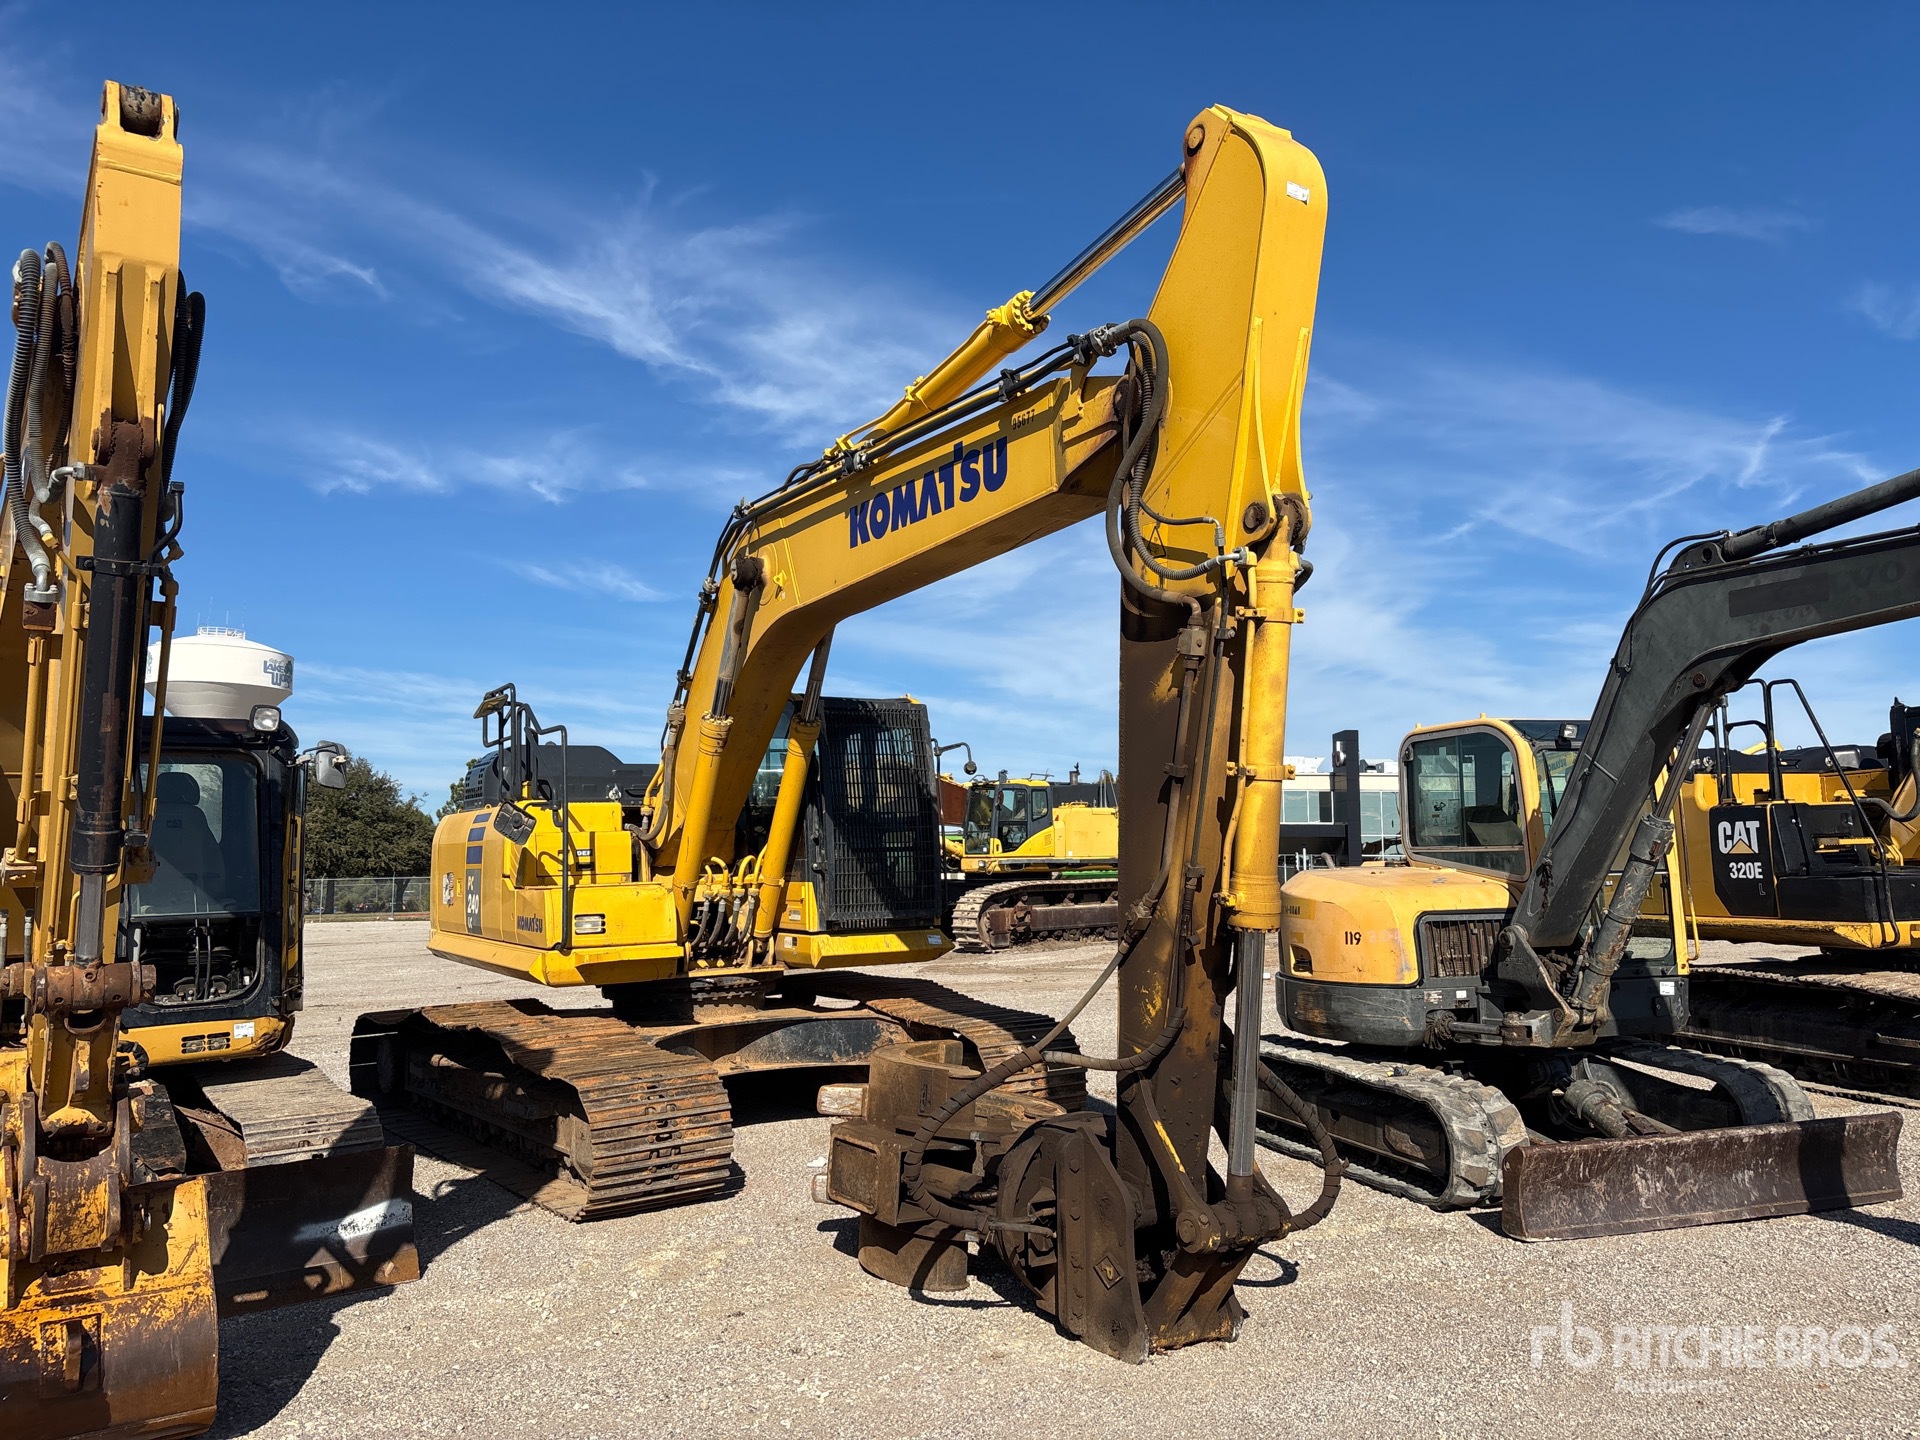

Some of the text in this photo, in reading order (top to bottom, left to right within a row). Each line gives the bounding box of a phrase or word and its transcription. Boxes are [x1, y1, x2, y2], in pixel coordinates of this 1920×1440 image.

[1012, 409, 1035, 430] 95677
[850, 436, 1008, 549] KOMATSU
[1717, 820, 1760, 855] CAT
[1729, 862, 1764, 879] 320E
[467, 875, 474, 890] PC
[1758, 883, 1766, 895] L
[467, 893, 480, 915] 240
[517, 913, 543, 933] KOMATSU
[1344, 931, 1362, 945] 119
